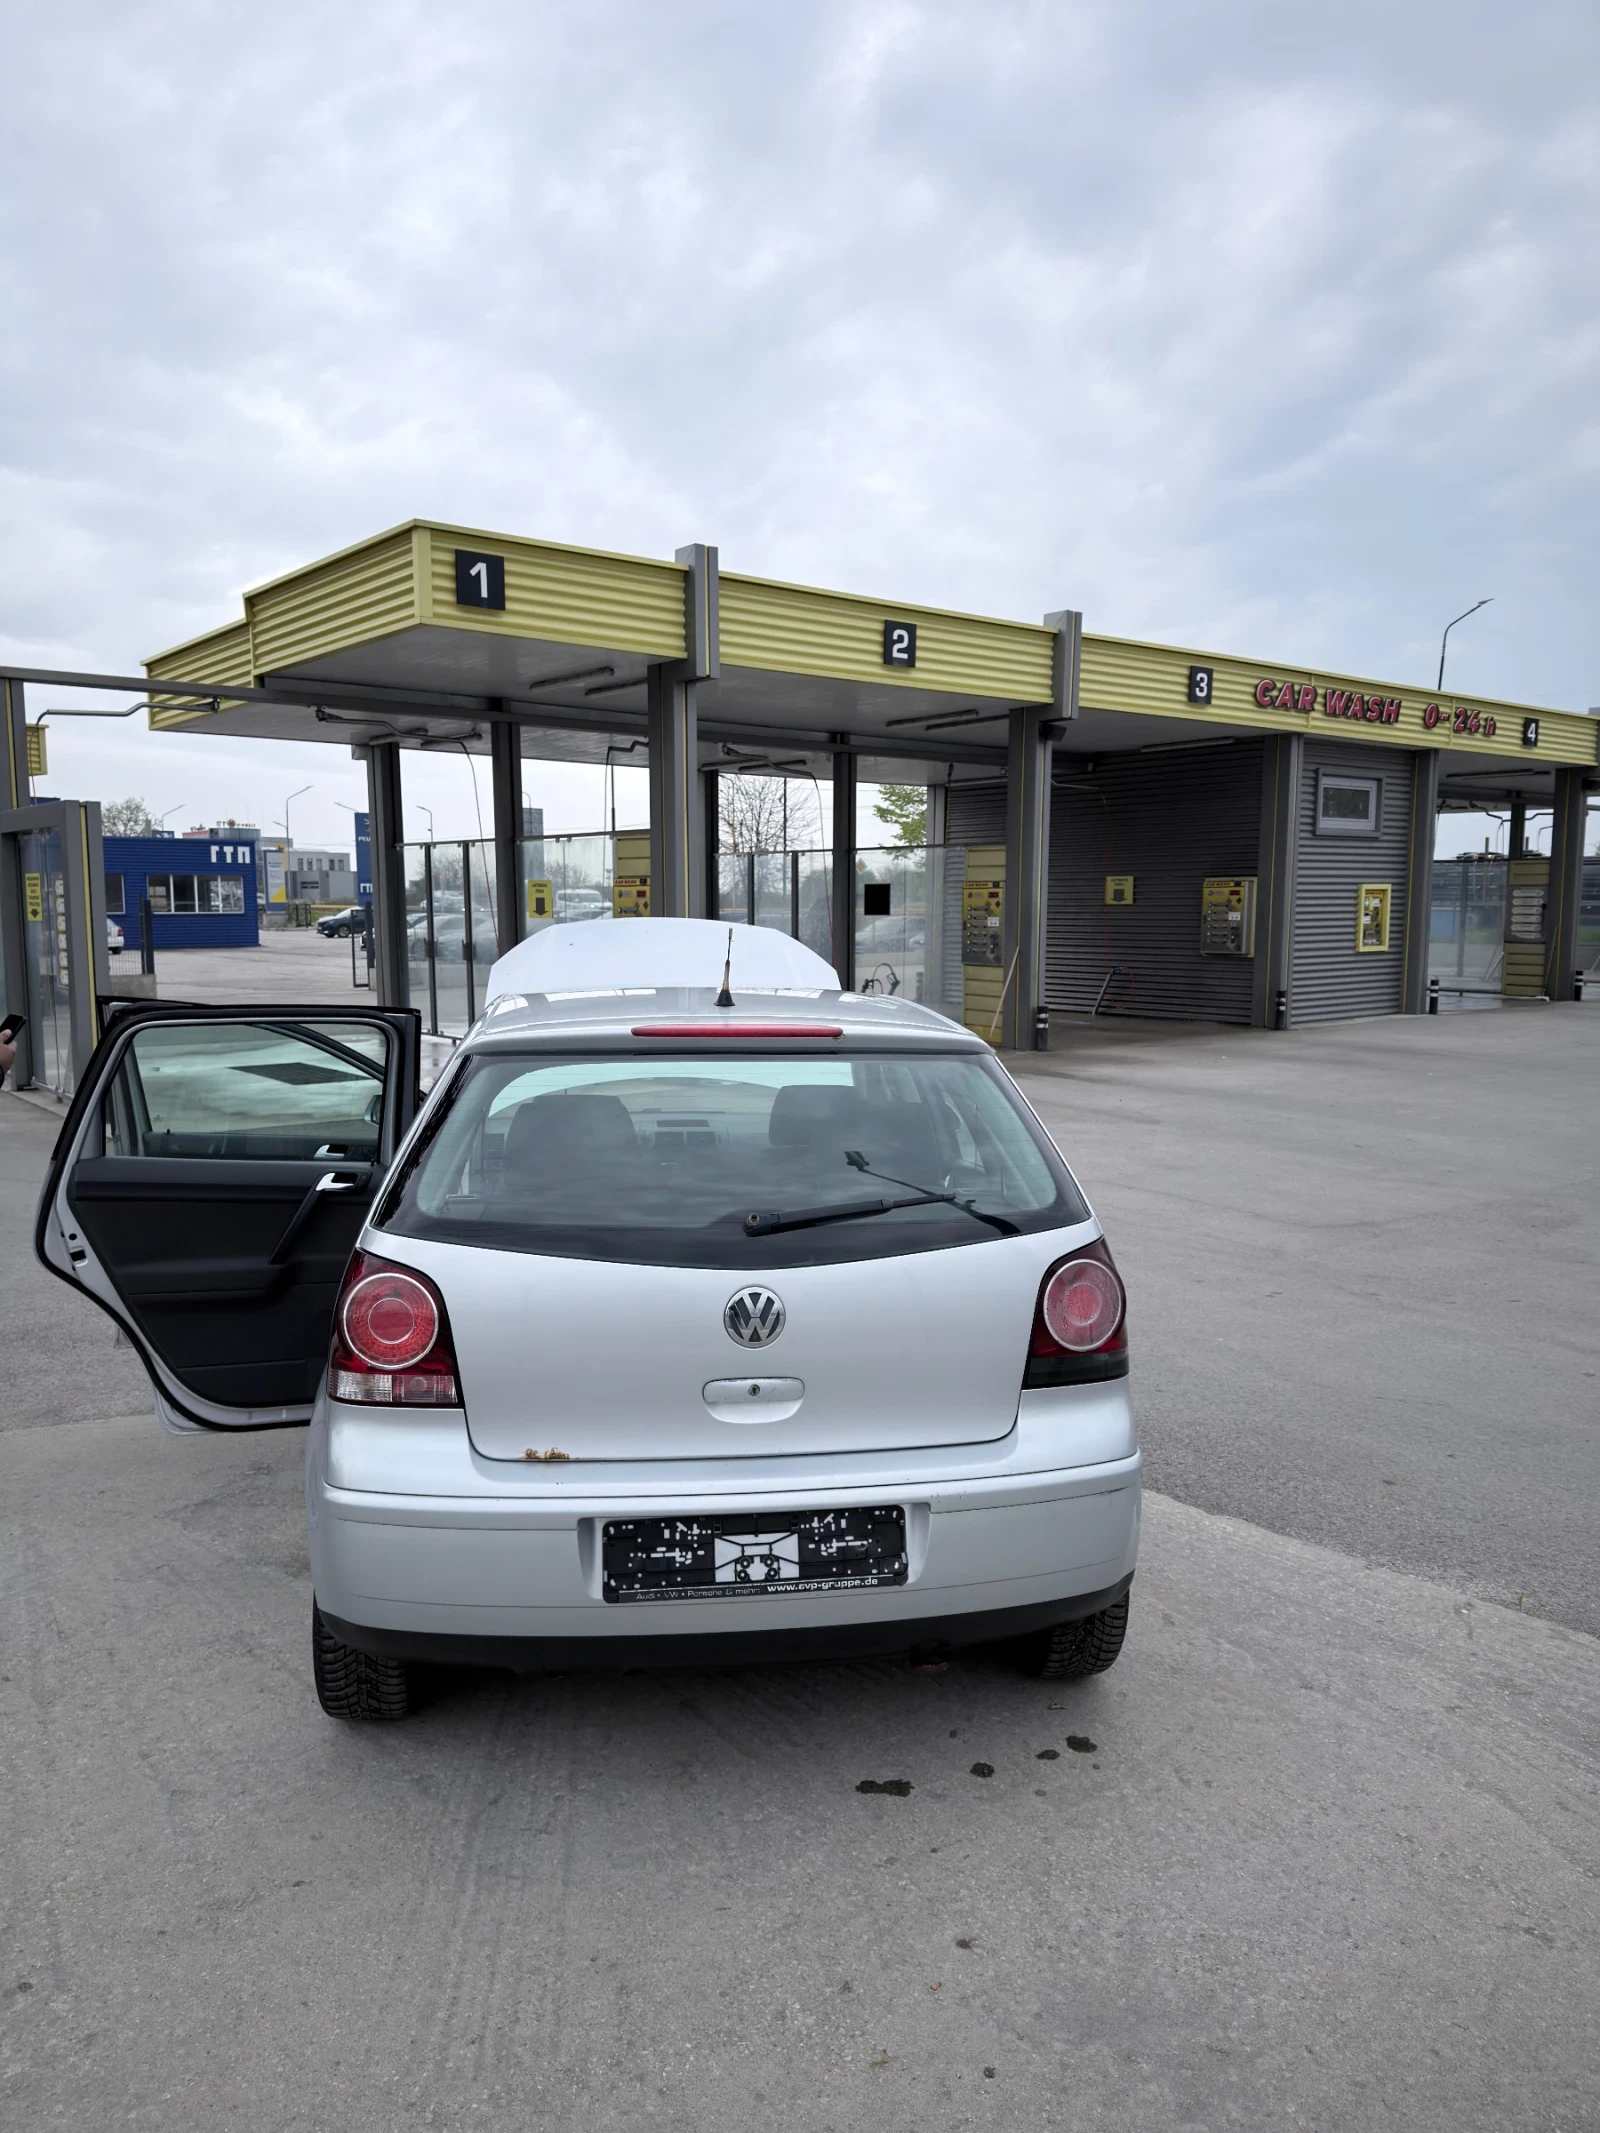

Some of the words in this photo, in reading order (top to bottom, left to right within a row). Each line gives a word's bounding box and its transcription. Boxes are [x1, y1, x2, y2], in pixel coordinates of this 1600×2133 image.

[469, 562, 488, 598] 1
[892, 629, 909, 660] 2
[1195, 672, 1208, 697] 3
[1255, 679, 1317, 711] CAR
[1325, 689, 1400, 723] WASH
[1527, 722, 1536, 742] 4
[210, 845, 251, 864] ГТП
[723, 1285, 786, 1349] VW
[636, 1592, 656, 1600] Audi
